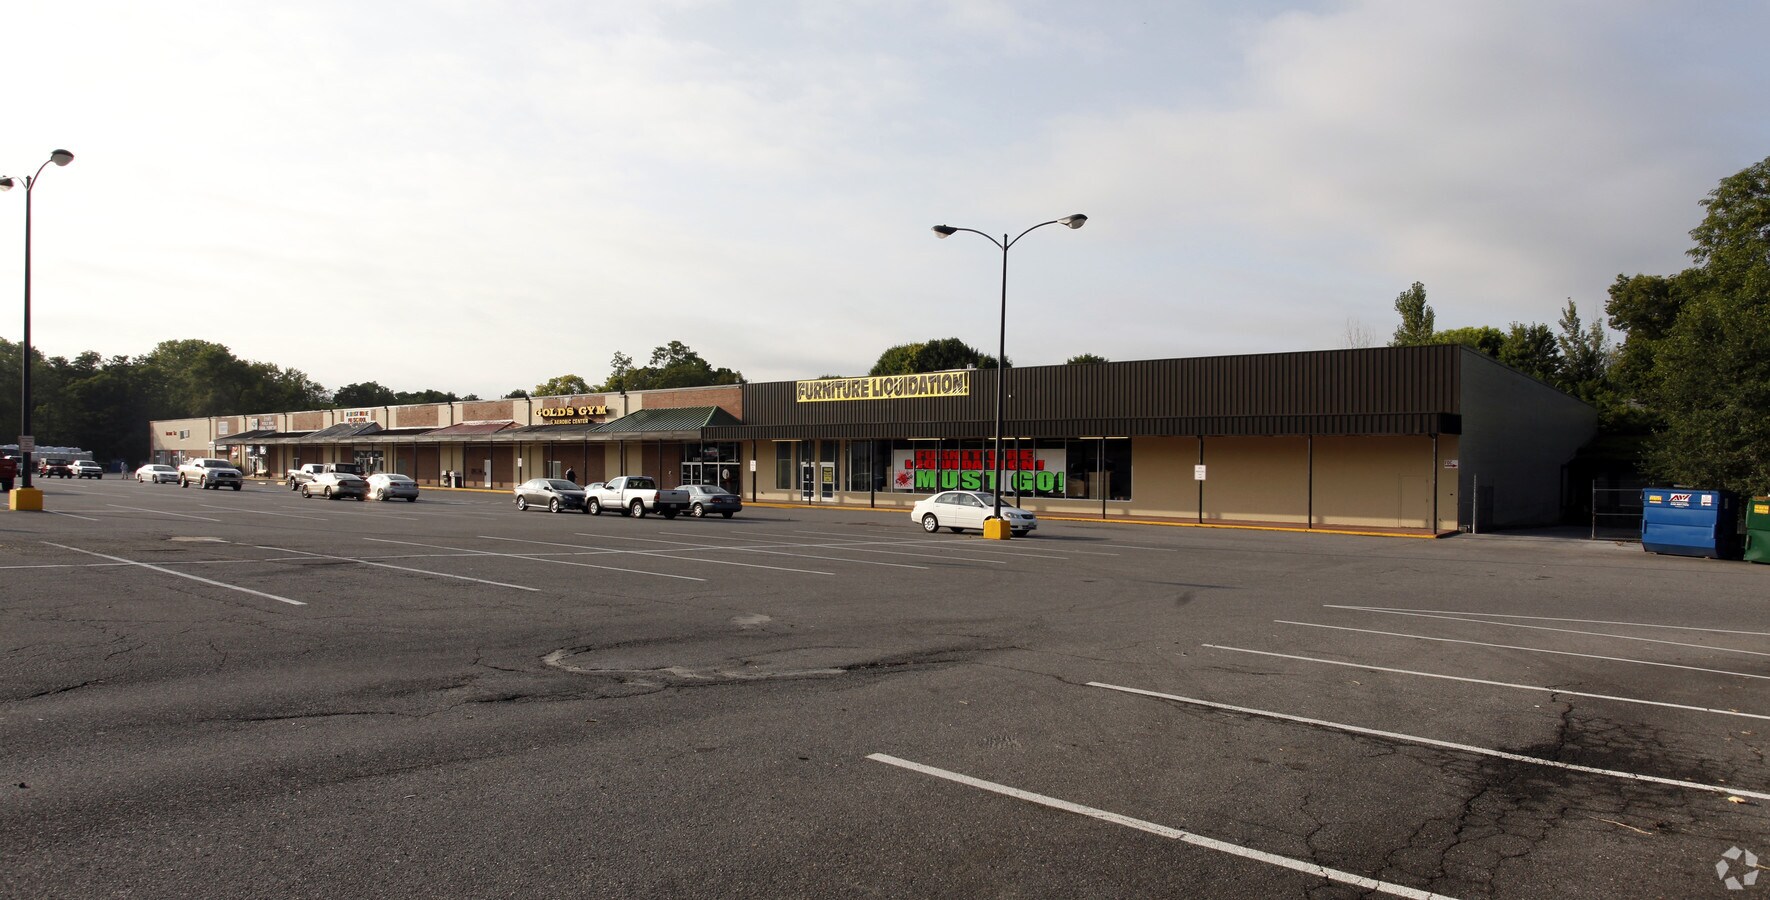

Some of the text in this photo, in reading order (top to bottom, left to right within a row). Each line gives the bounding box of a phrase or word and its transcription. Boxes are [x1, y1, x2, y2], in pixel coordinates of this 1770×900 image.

[798, 372, 969, 400] FURNITURE LIQUIDATION!
[578, 405, 607, 416] GYM
[915, 469, 1065, 493] MUST GO!
